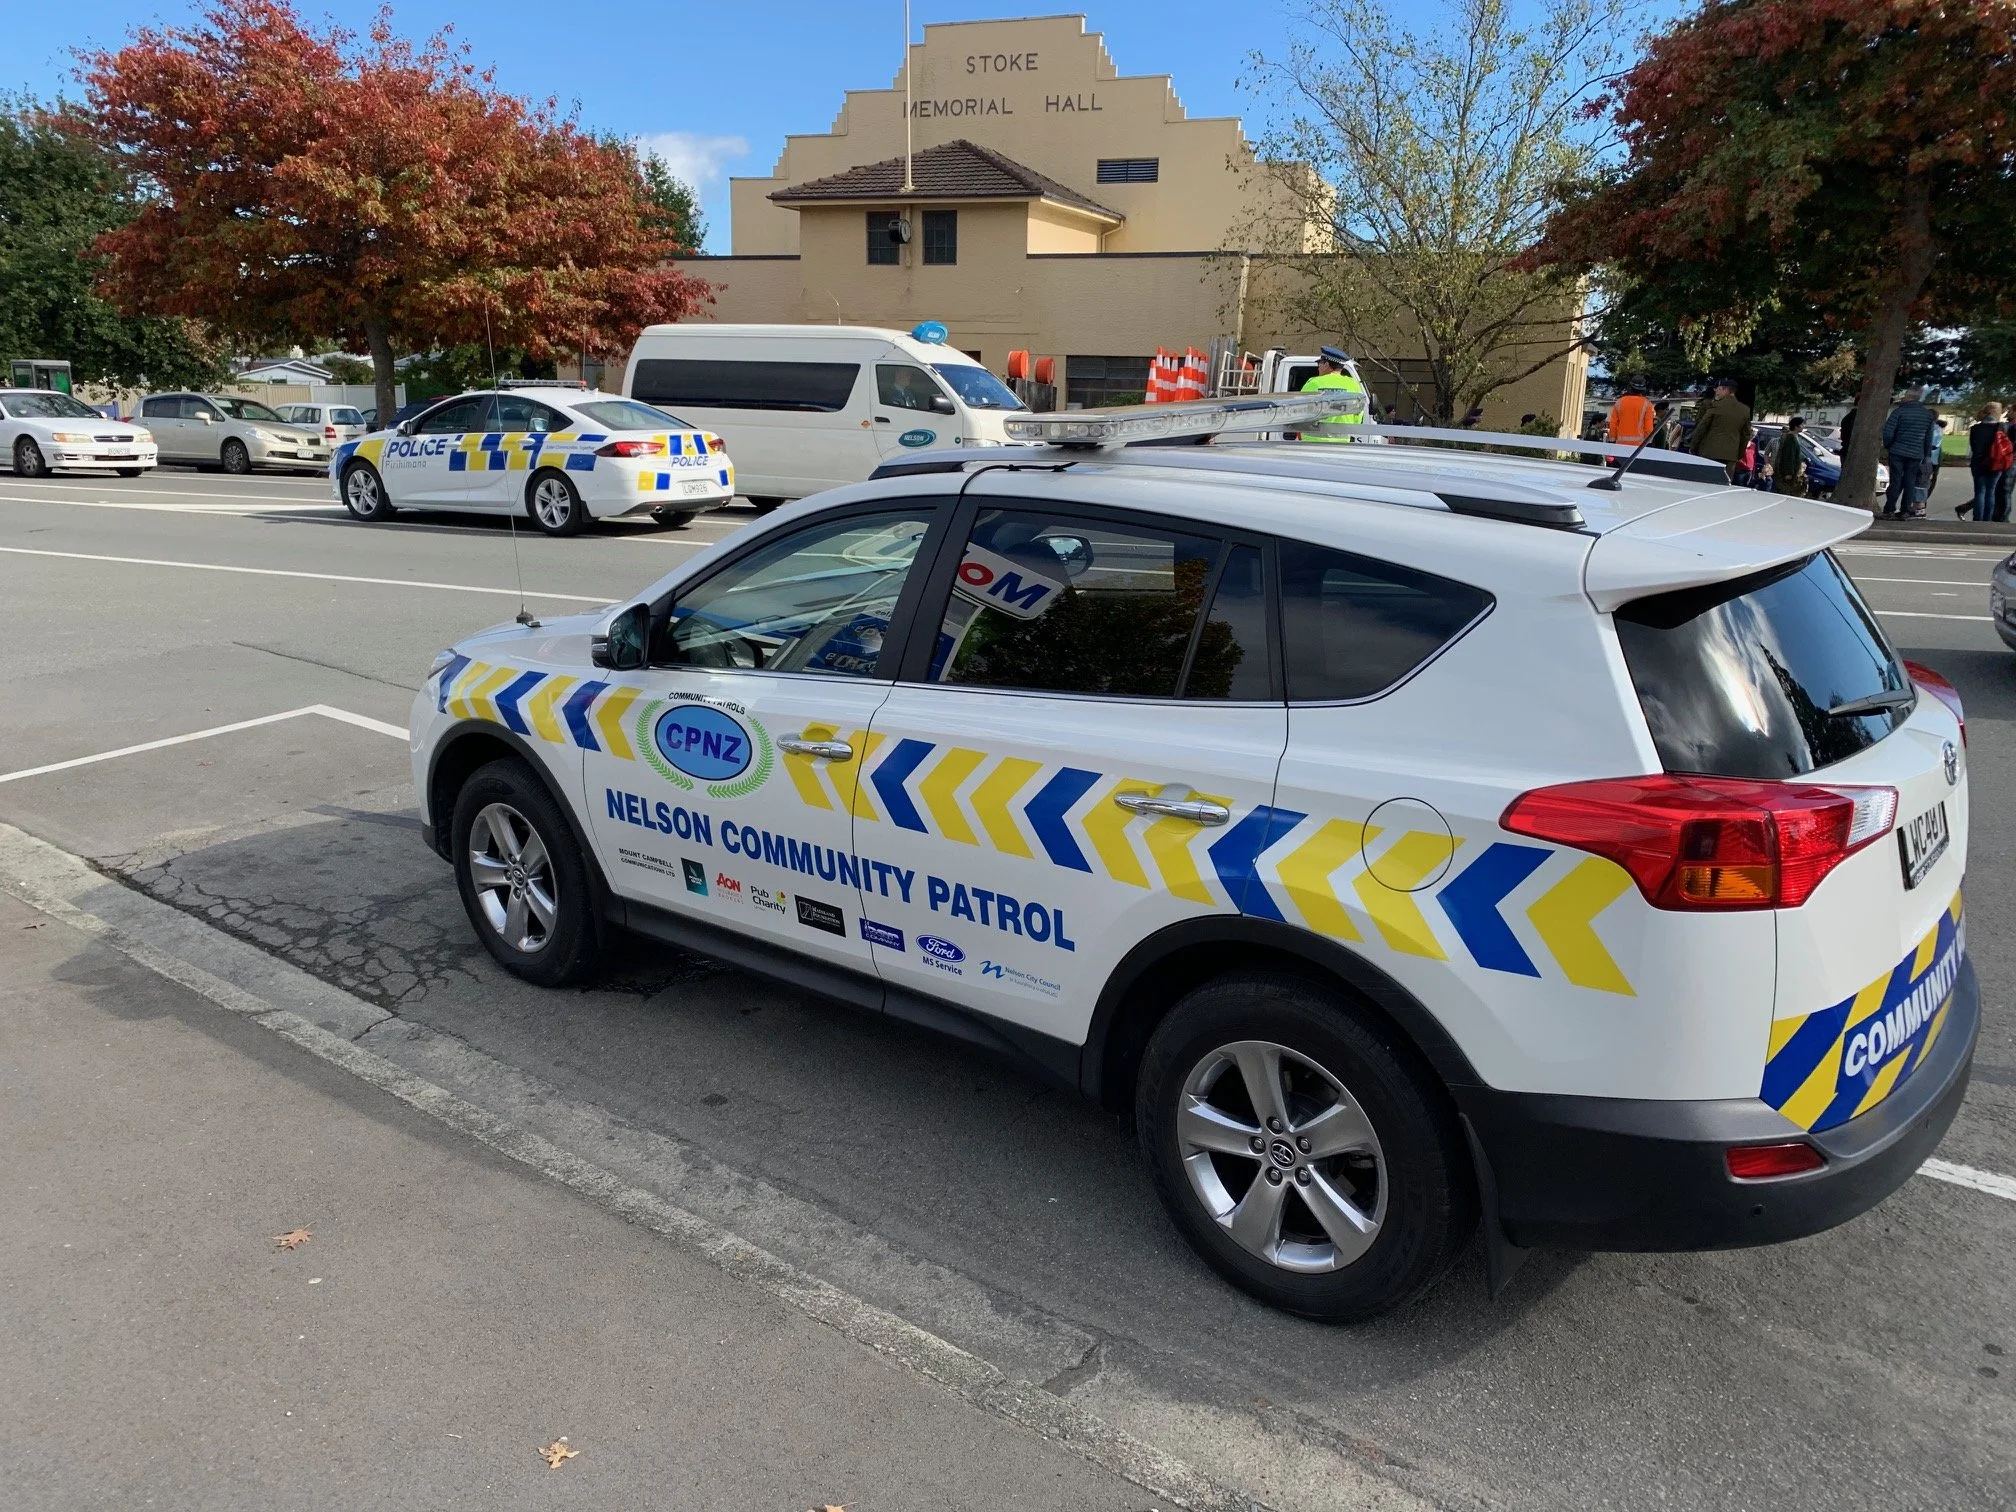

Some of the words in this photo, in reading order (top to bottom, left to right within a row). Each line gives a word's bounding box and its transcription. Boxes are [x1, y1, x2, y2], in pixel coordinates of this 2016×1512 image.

[966, 53, 1038, 74] STOKE
[903, 97, 1014, 118] MEMORIAL
[1045, 93, 1103, 112] HALL
[387, 439, 448, 458] POLICE
[671, 456, 709, 467] POLICE
[666, 722, 742, 765] CPNZ
[618, 847, 641, 859] MOUNT
[641, 854, 674, 869] CAMPBELL
[620, 857, 666, 874] COMMUNICATIONS
[665, 870, 676, 878] LTD
[606, 788, 713, 847] NELSON
[720, 820, 915, 903] COMMUNITY
[927, 875, 1075, 952] PATROL
[750, 885, 770, 898] Pub
[752, 895, 786, 914] Charity
[925, 938, 956, 959] Ford
[922, 956, 934, 966] MS
[935, 959, 963, 976] Service
[1005, 966, 1025, 979] Nelson
[1025, 973, 1038, 984] City
[1039, 978, 1061, 991] Council
[1845, 937, 1957, 1077] COMMUNITY
